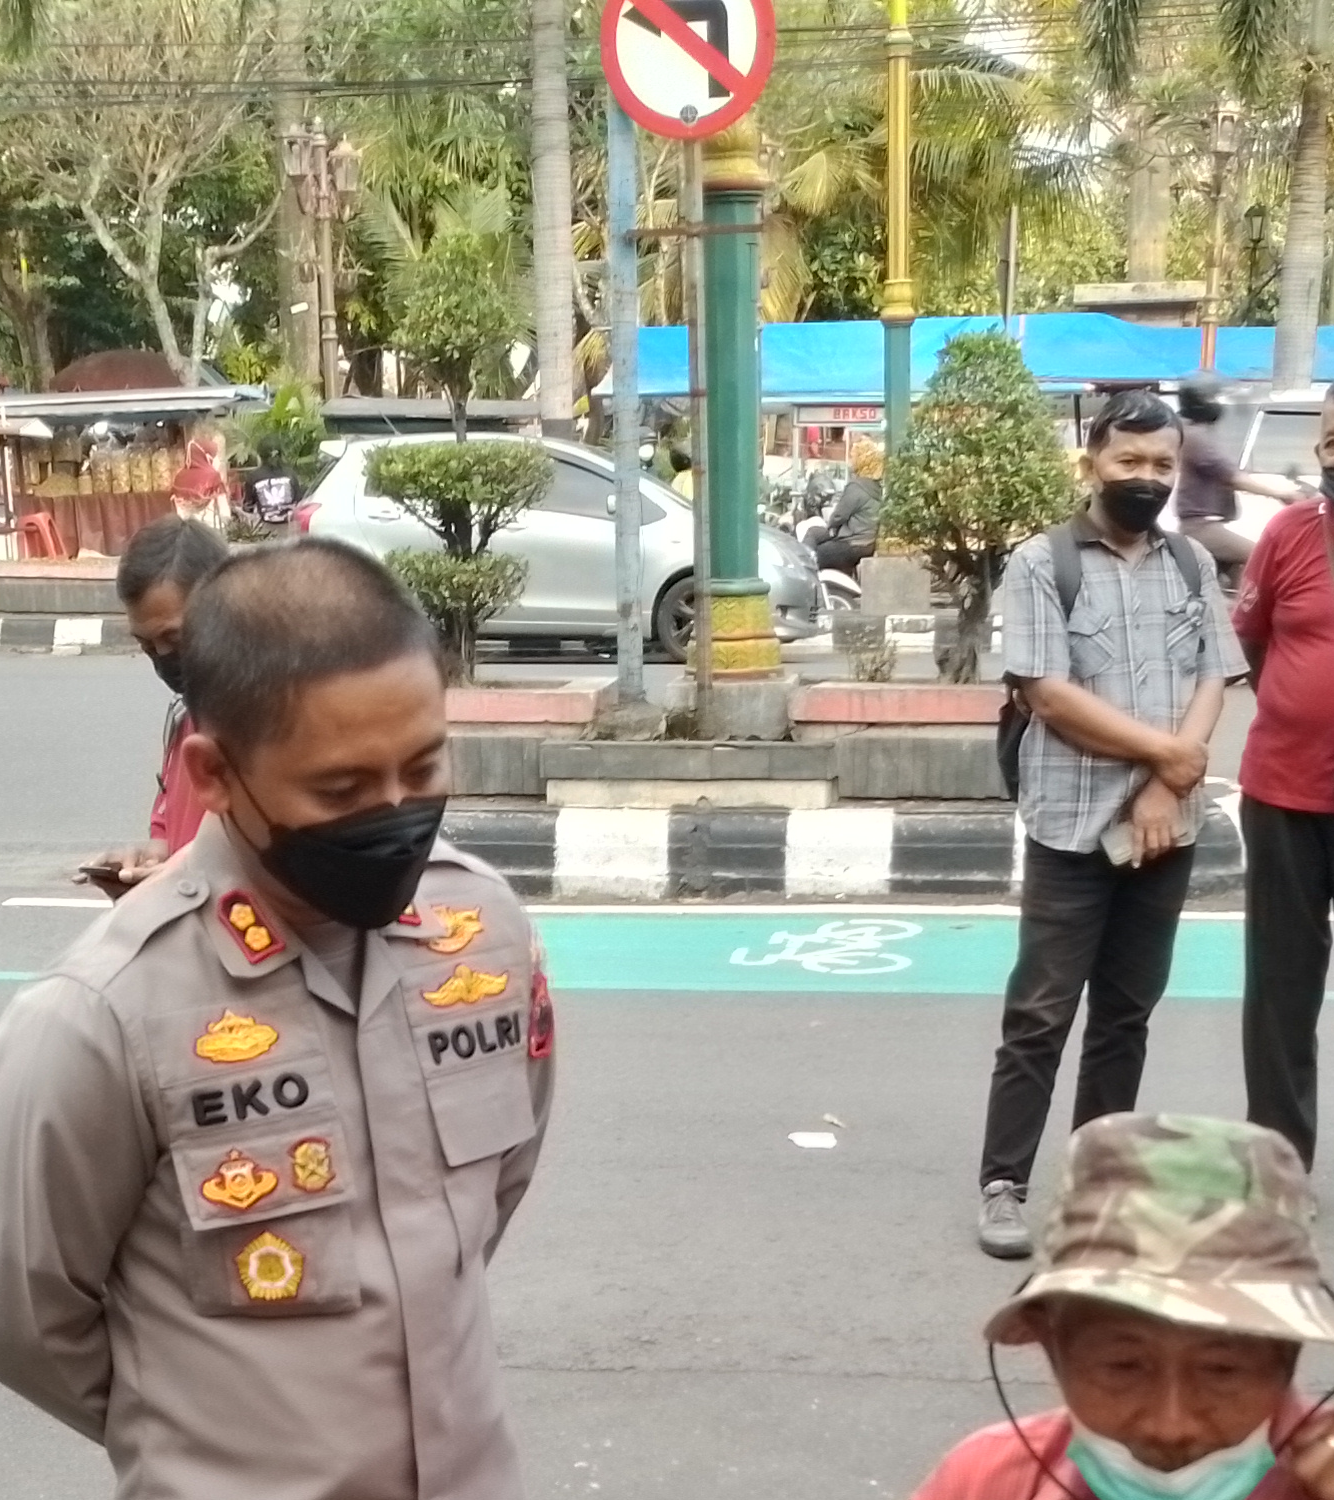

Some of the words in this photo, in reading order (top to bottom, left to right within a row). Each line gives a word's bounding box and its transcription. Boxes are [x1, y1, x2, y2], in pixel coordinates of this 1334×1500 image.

[833, 408, 877, 420] BAKSO
[427, 1012, 522, 1066] POLRI
[192, 1072, 310, 1128] EKO
